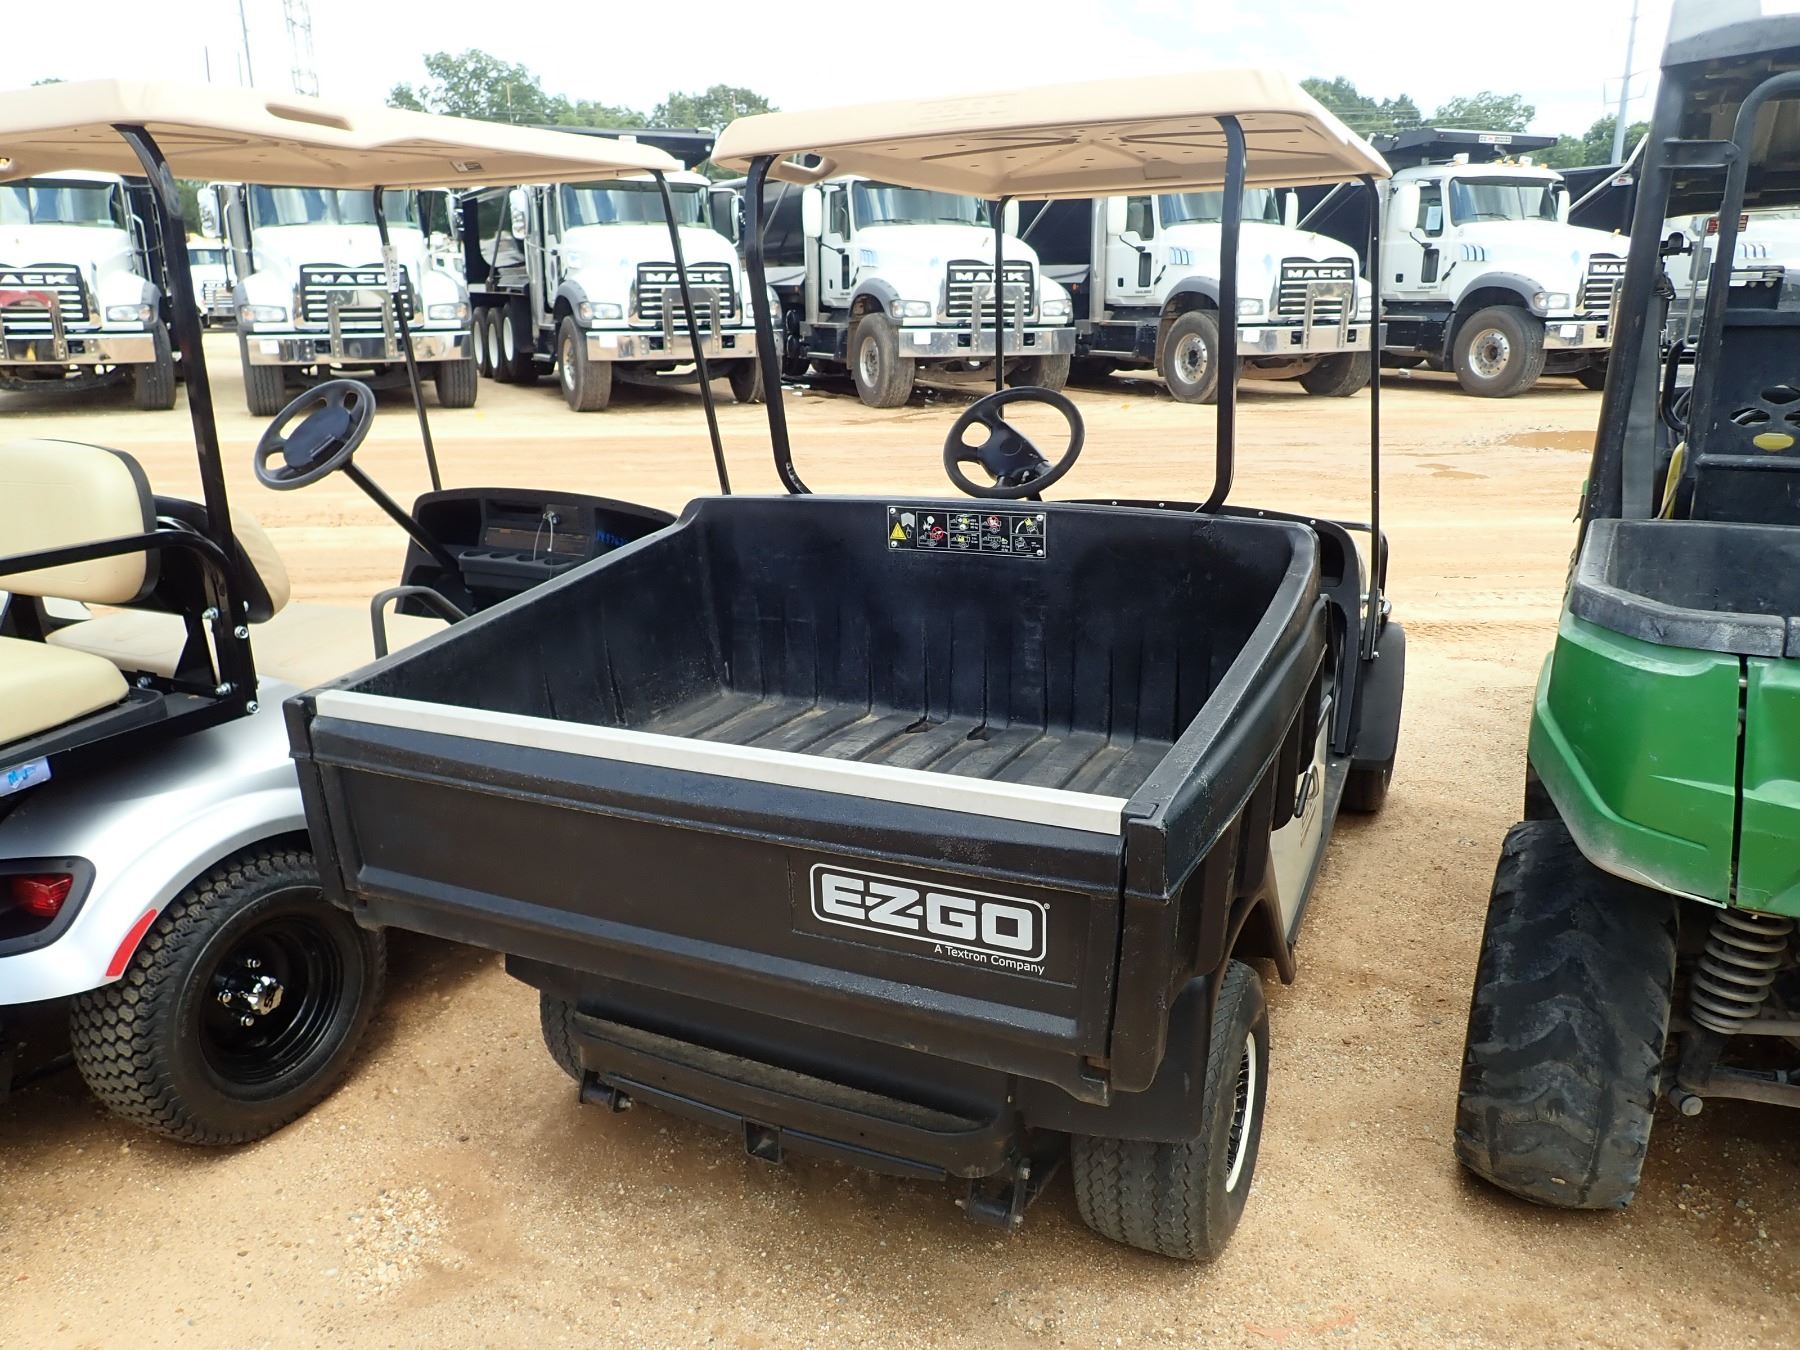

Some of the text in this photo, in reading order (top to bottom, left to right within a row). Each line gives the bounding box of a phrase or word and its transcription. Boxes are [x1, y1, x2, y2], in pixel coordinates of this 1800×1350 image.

[646, 272, 723, 282] MACK
[1288, 269, 1346, 278] MACK
[0, 274, 70, 284] ACK
[821, 873, 1033, 951] EZGO
[934, 944, 1045, 975] A Textron Company
